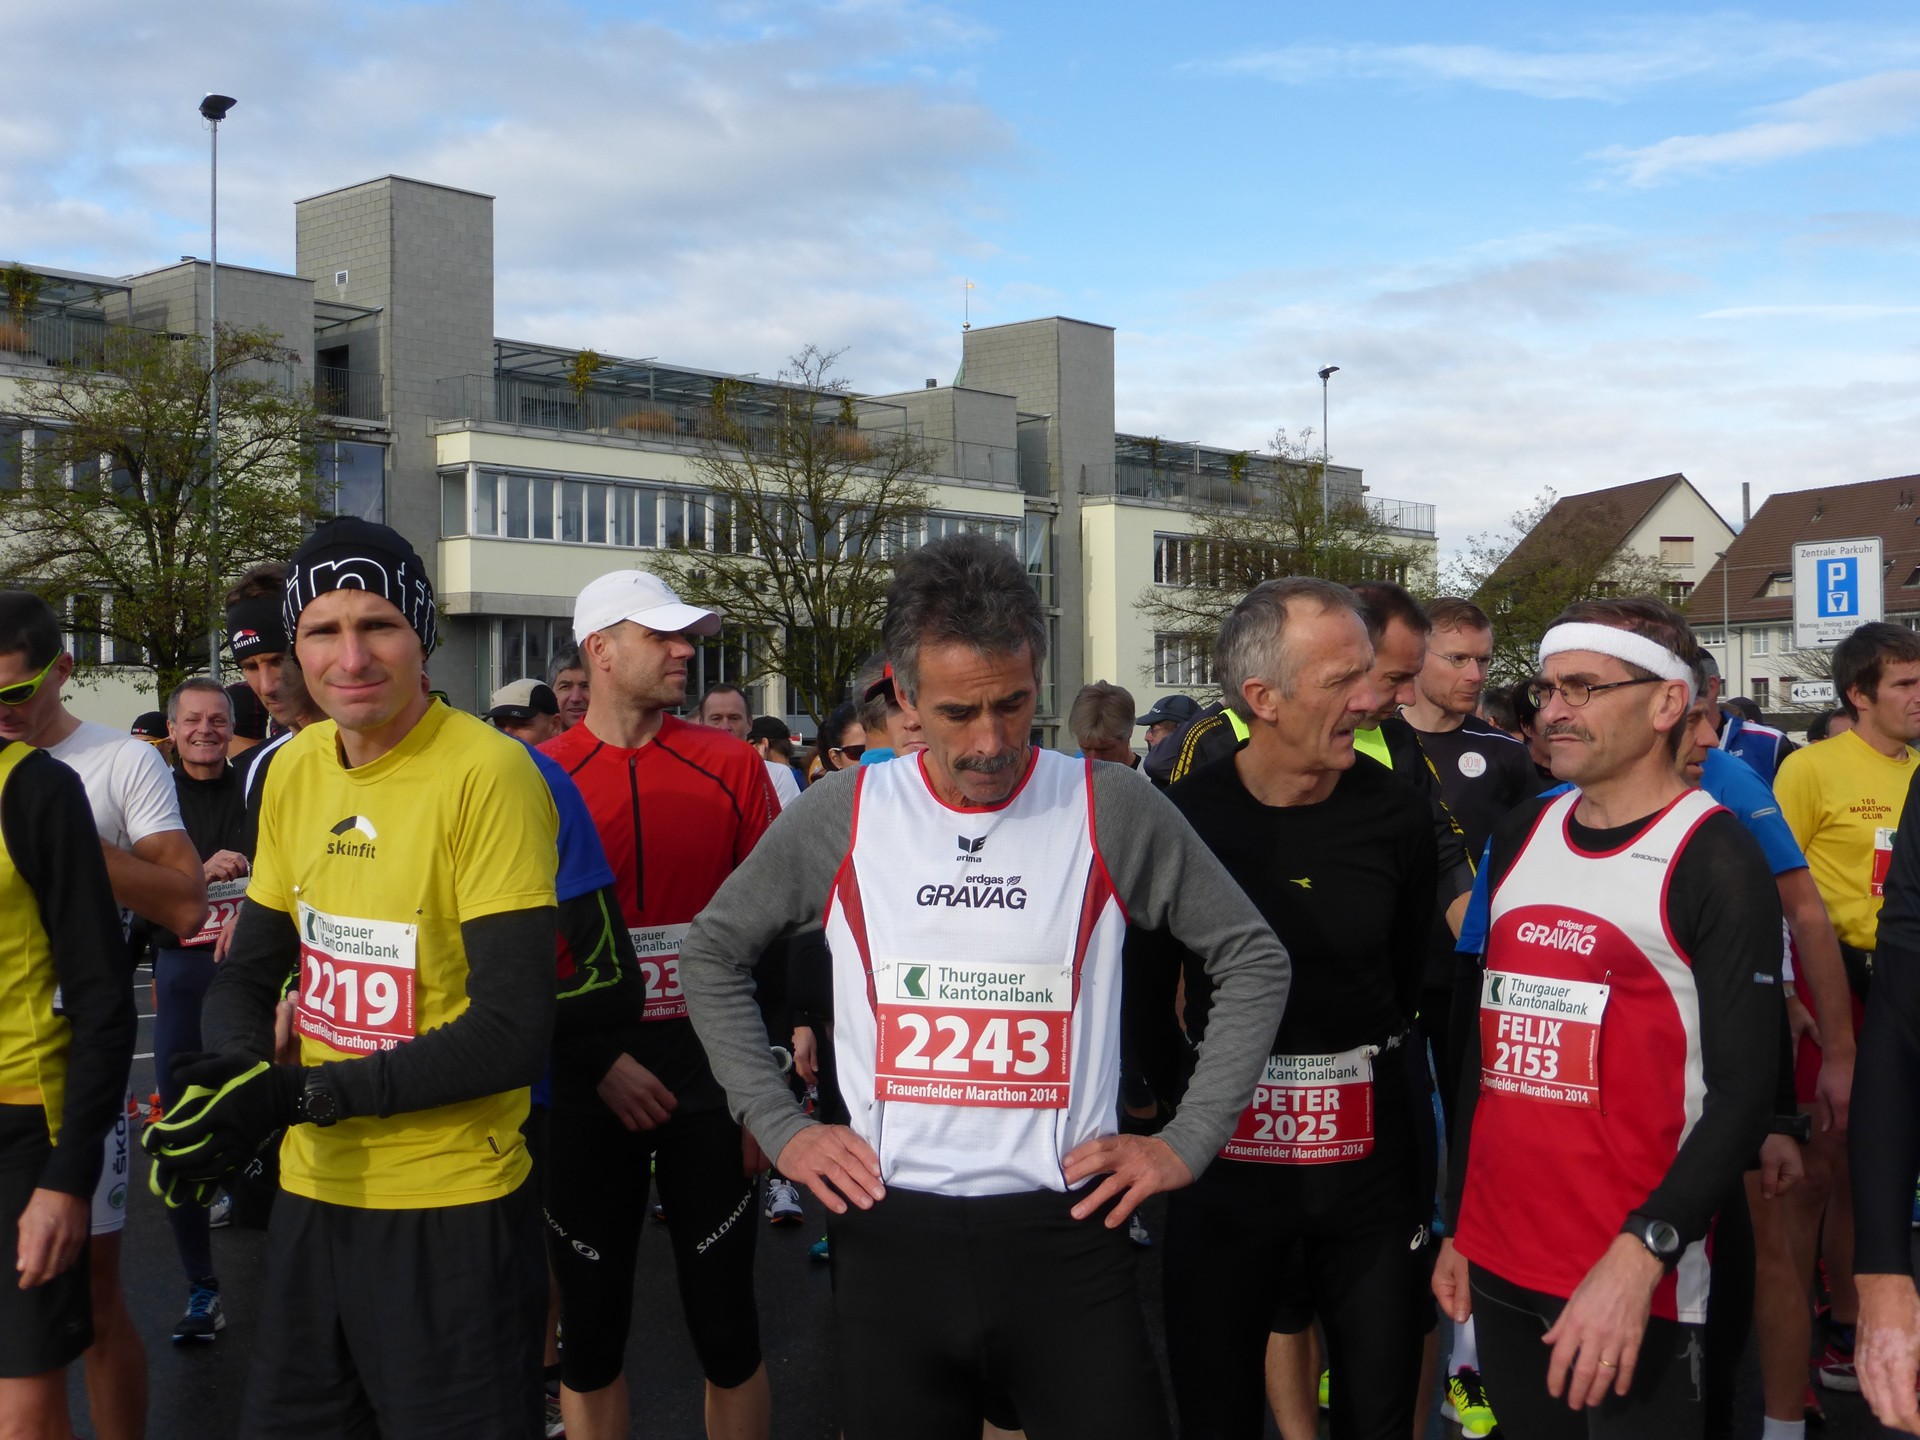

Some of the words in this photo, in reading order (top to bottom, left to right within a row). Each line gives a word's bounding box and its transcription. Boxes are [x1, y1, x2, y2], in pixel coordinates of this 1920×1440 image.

[1801, 547, 1836, 558] Zentrale
[1840, 544, 1873, 555] Parkuhr
[1827, 562, 1847, 591] P
[233, 635, 261, 650] skinfit
[1819, 686, 1832, 696] WC
[1849, 805, 1891, 813] MARATHON
[326, 839, 376, 859] skinfit
[956, 854, 982, 863] erima
[1631, 852, 1668, 864] BROOKS
[208, 882, 236, 892] urgauer
[965, 874, 1004, 886] erdgas
[916, 884, 1028, 910] GRAVAG
[204, 900, 245, 930] 22
[1556, 919, 1584, 932] erdgas
[317, 915, 374, 940] Thurgauer
[1516, 921, 1596, 956] GRAVAG
[320, 933, 399, 959] Kantonalbank
[635, 939, 683, 953] onalban
[939, 966, 1026, 988] Thurgauer
[1511, 977, 1571, 998] Thurgauer
[304, 954, 399, 1026] 2219
[939, 984, 1054, 1004] Kantonalbank
[1508, 992, 1589, 1016] Kantonalbank
[300, 1014, 333, 1041] Frauenfelder
[332, 1031, 378, 1051] Marathon
[1497, 1013, 1563, 1047] FELIX
[894, 1012, 1050, 1076] 2243
[1268, 1054, 1336, 1070] Thurgauer
[1493, 1041, 1559, 1080] 2153
[1267, 1065, 1359, 1081] Kantonalbank
[886, 1080, 964, 1100] Frauenfelder
[965, 1085, 1027, 1102] Marathon
[1029, 1087, 1058, 1103] 2014
[1252, 1087, 1341, 1112] PETER
[1484, 1073, 1520, 1093] Frauenfelder
[1520, 1081, 1563, 1100] Marathon
[1565, 1088, 1589, 1104] 2014
[1253, 1112, 1338, 1142] 2025
[1225, 1144, 1290, 1159] Frauenfelder
[1292, 1145, 1340, 1159] Marathon
[1342, 1143, 1364, 1155] 2014
[696, 1189, 752, 1254] SALOMON
